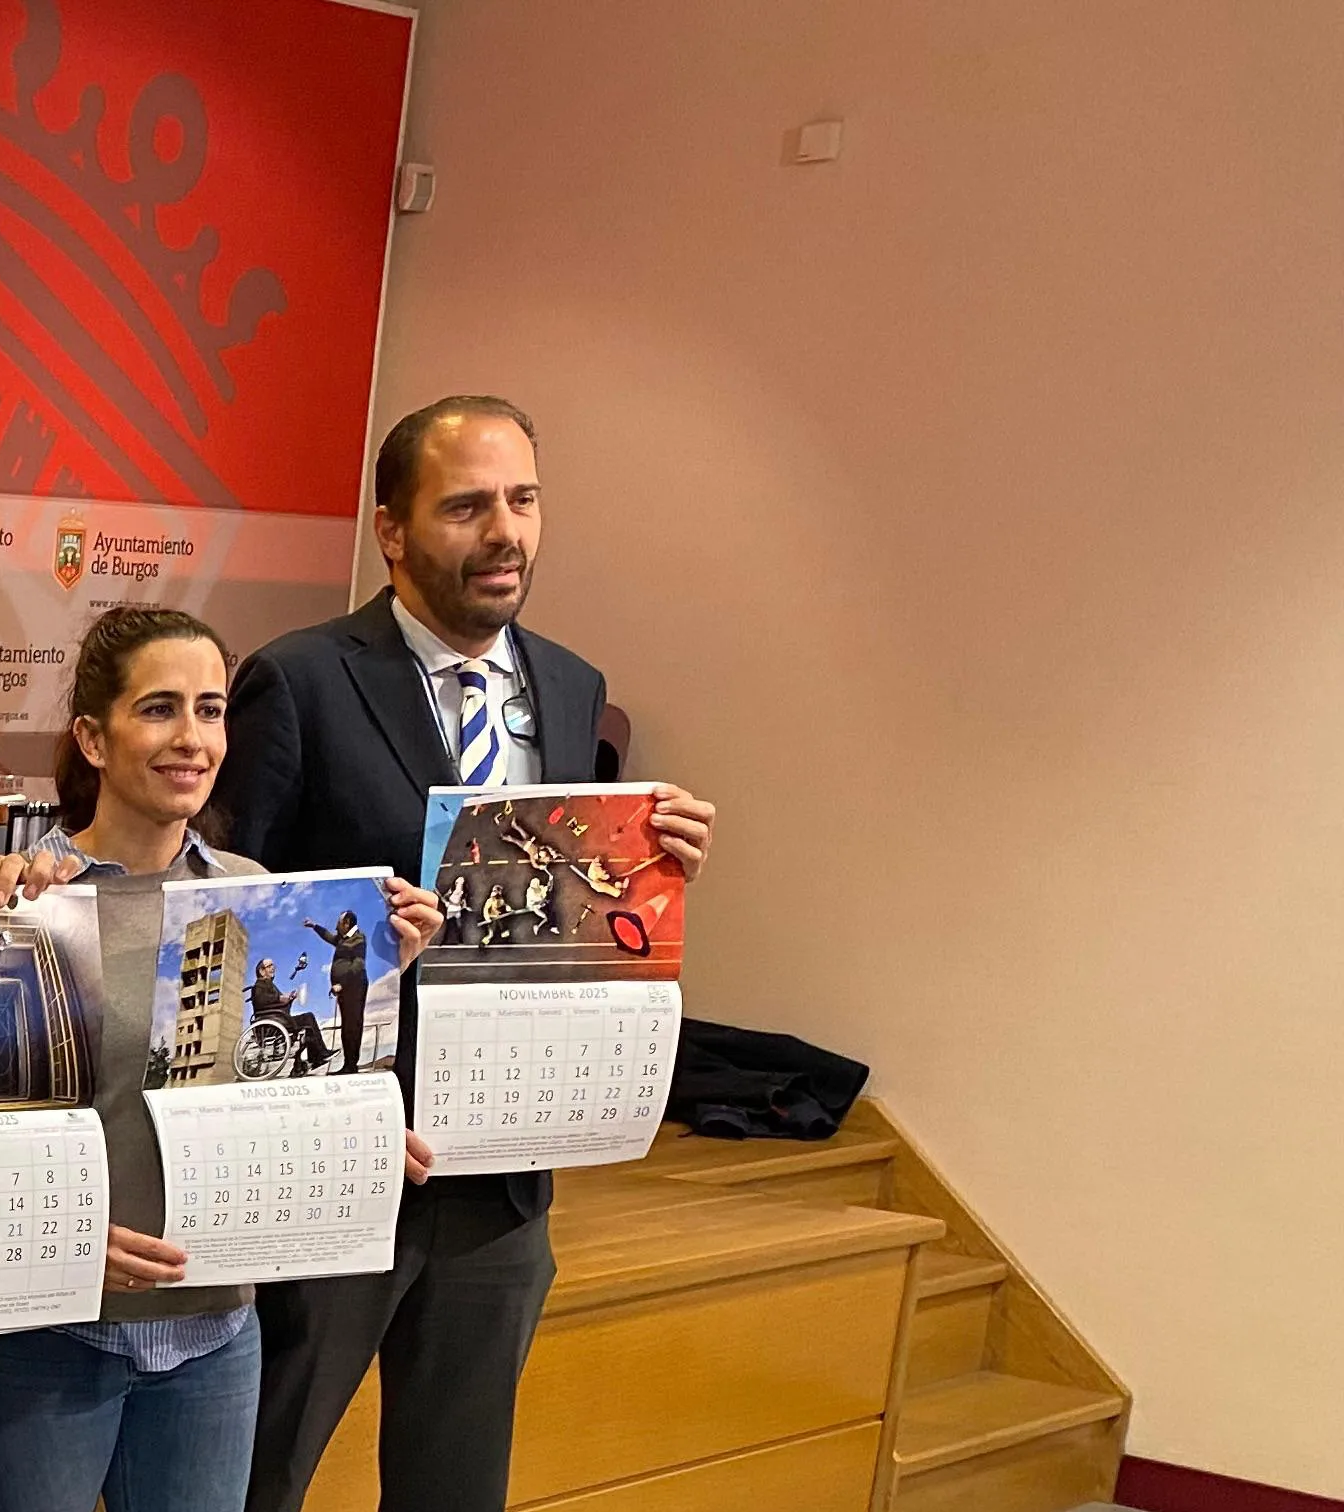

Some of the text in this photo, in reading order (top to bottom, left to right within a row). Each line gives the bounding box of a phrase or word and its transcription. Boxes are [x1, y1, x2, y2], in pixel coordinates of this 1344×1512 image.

[93, 532, 194, 557] Ayuntamiento
[91, 554, 159, 581] de Burgos
[579, 987, 609, 999] 2025
[434, 1063, 658, 1083] 10 11 12 13 14 15 16
[241, 1085, 310, 1099] MAYO 2025
[9, 1196, 25, 1212] 14
[43, 1194, 59, 1209] 15
[77, 1192, 93, 1207] 16
[181, 1205, 351, 1229] 26 27 28 29 30 31
